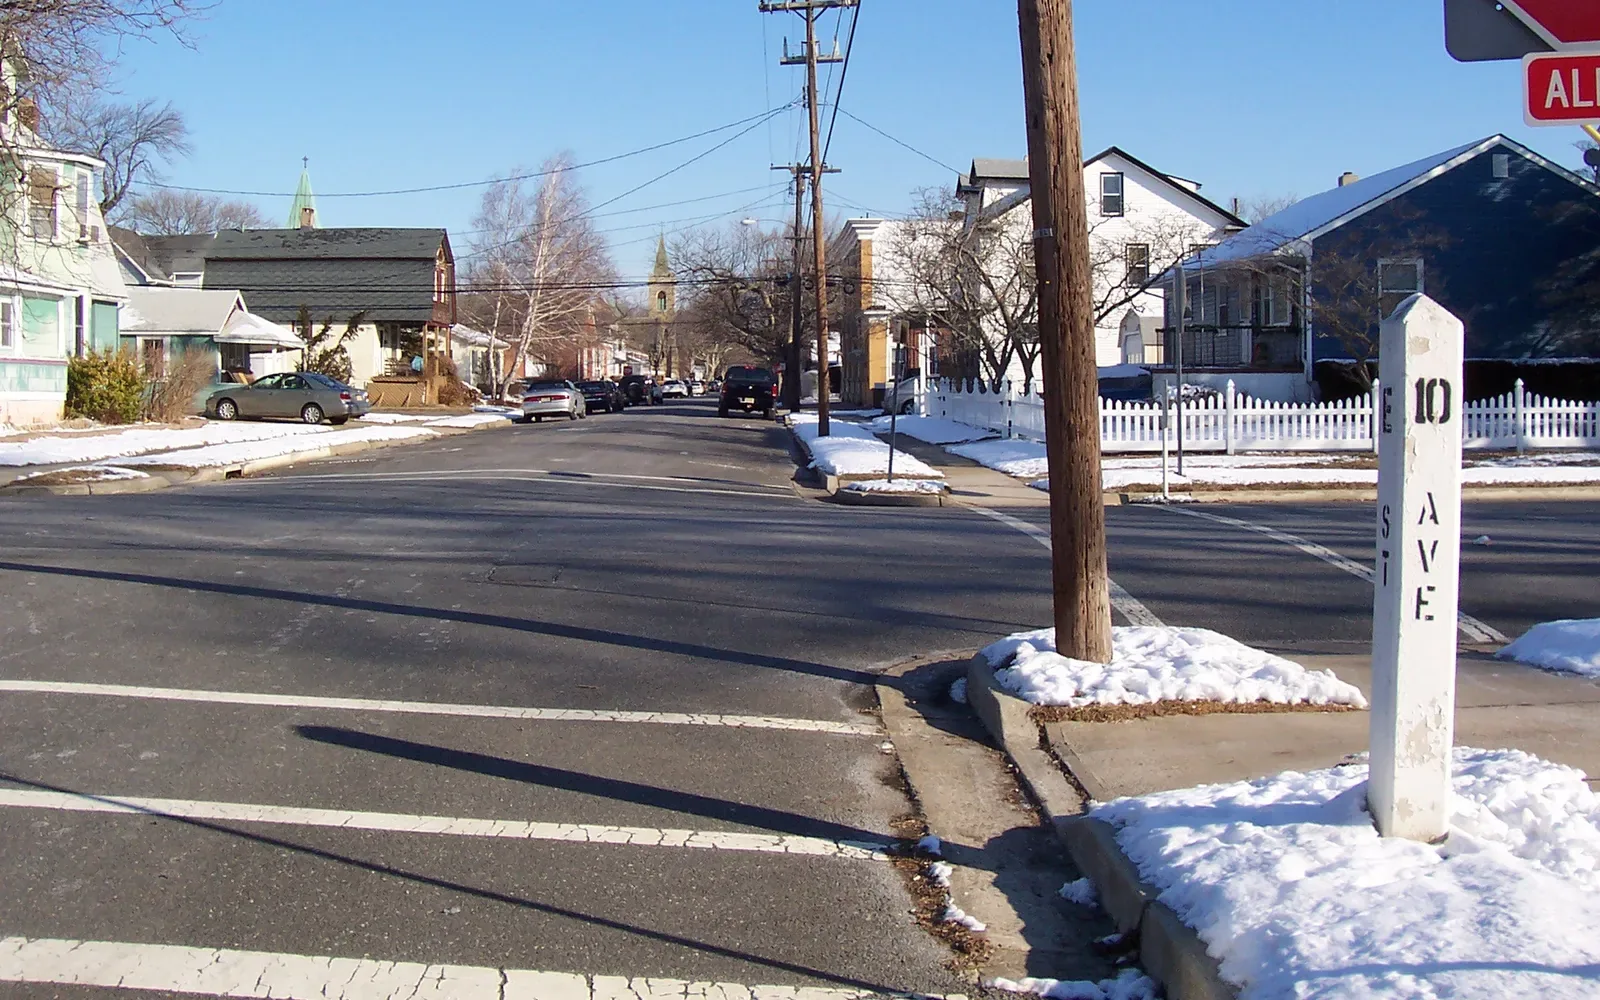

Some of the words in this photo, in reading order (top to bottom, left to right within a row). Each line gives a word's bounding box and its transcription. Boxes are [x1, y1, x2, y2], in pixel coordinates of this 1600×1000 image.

[1545, 67, 1600, 109] AL
[1383, 387, 1392, 433] E
[1415, 377, 1451, 424] 10
[1382, 504, 1390, 587] ST
[1415, 492, 1439, 621] AVE
